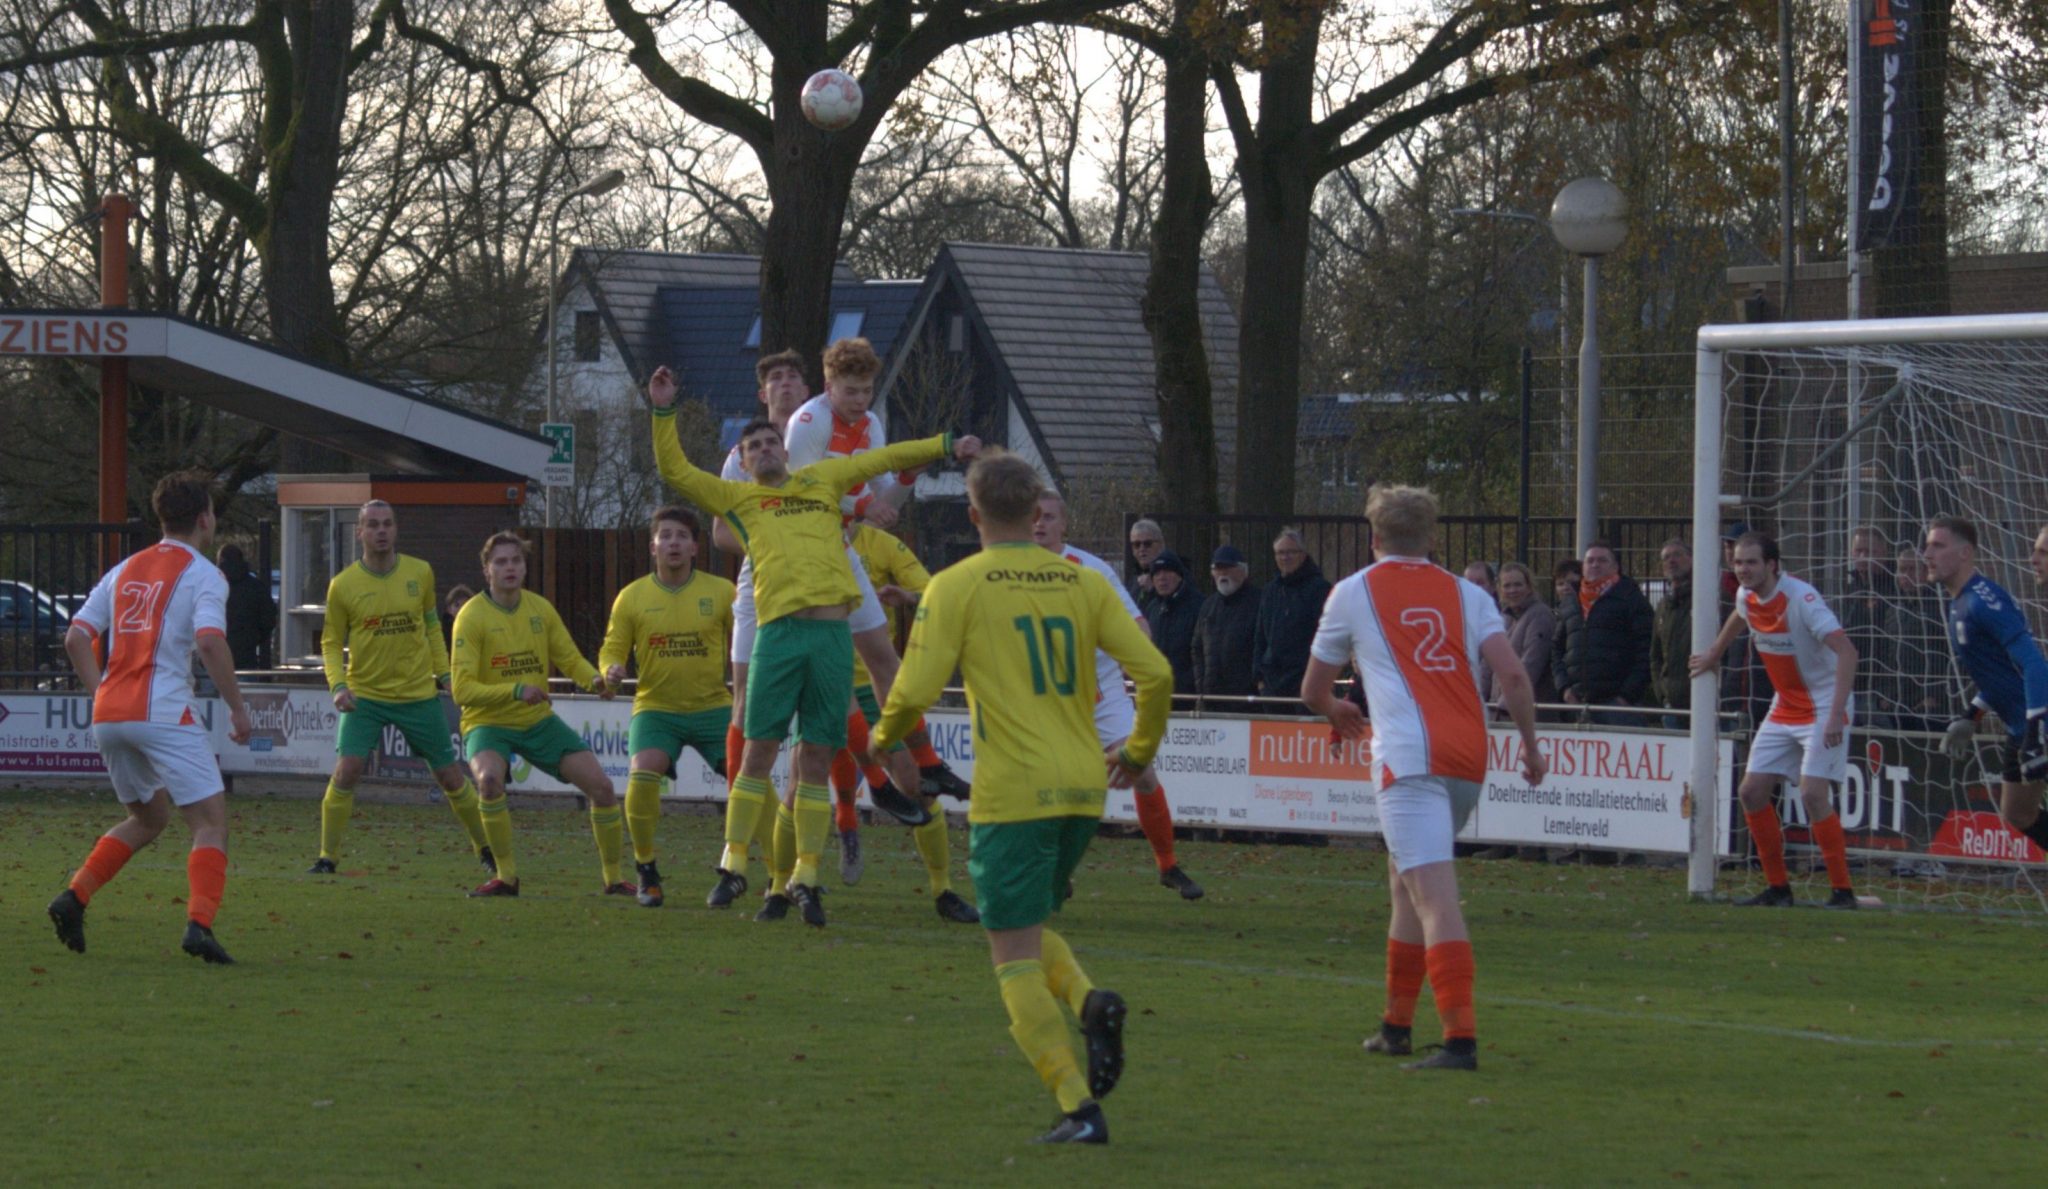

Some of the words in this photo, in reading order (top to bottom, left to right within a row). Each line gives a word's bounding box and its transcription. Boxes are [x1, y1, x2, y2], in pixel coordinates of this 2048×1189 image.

[0, 319, 128, 353] ZIENS
[119, 581, 164, 633] 21
[669, 636, 704, 649] frank
[1401, 607, 1456, 671] 2
[658, 647, 708, 658] overweg
[1014, 614, 1076, 696] 10
[66, 733, 78, 749] &
[1172, 728, 1217, 745] GEBRUIKT
[1488, 783, 1562, 806] Doeltreffende
[1565, 787, 1668, 813] installatietechniek
[1544, 816, 1609, 838] Lemelerveld
